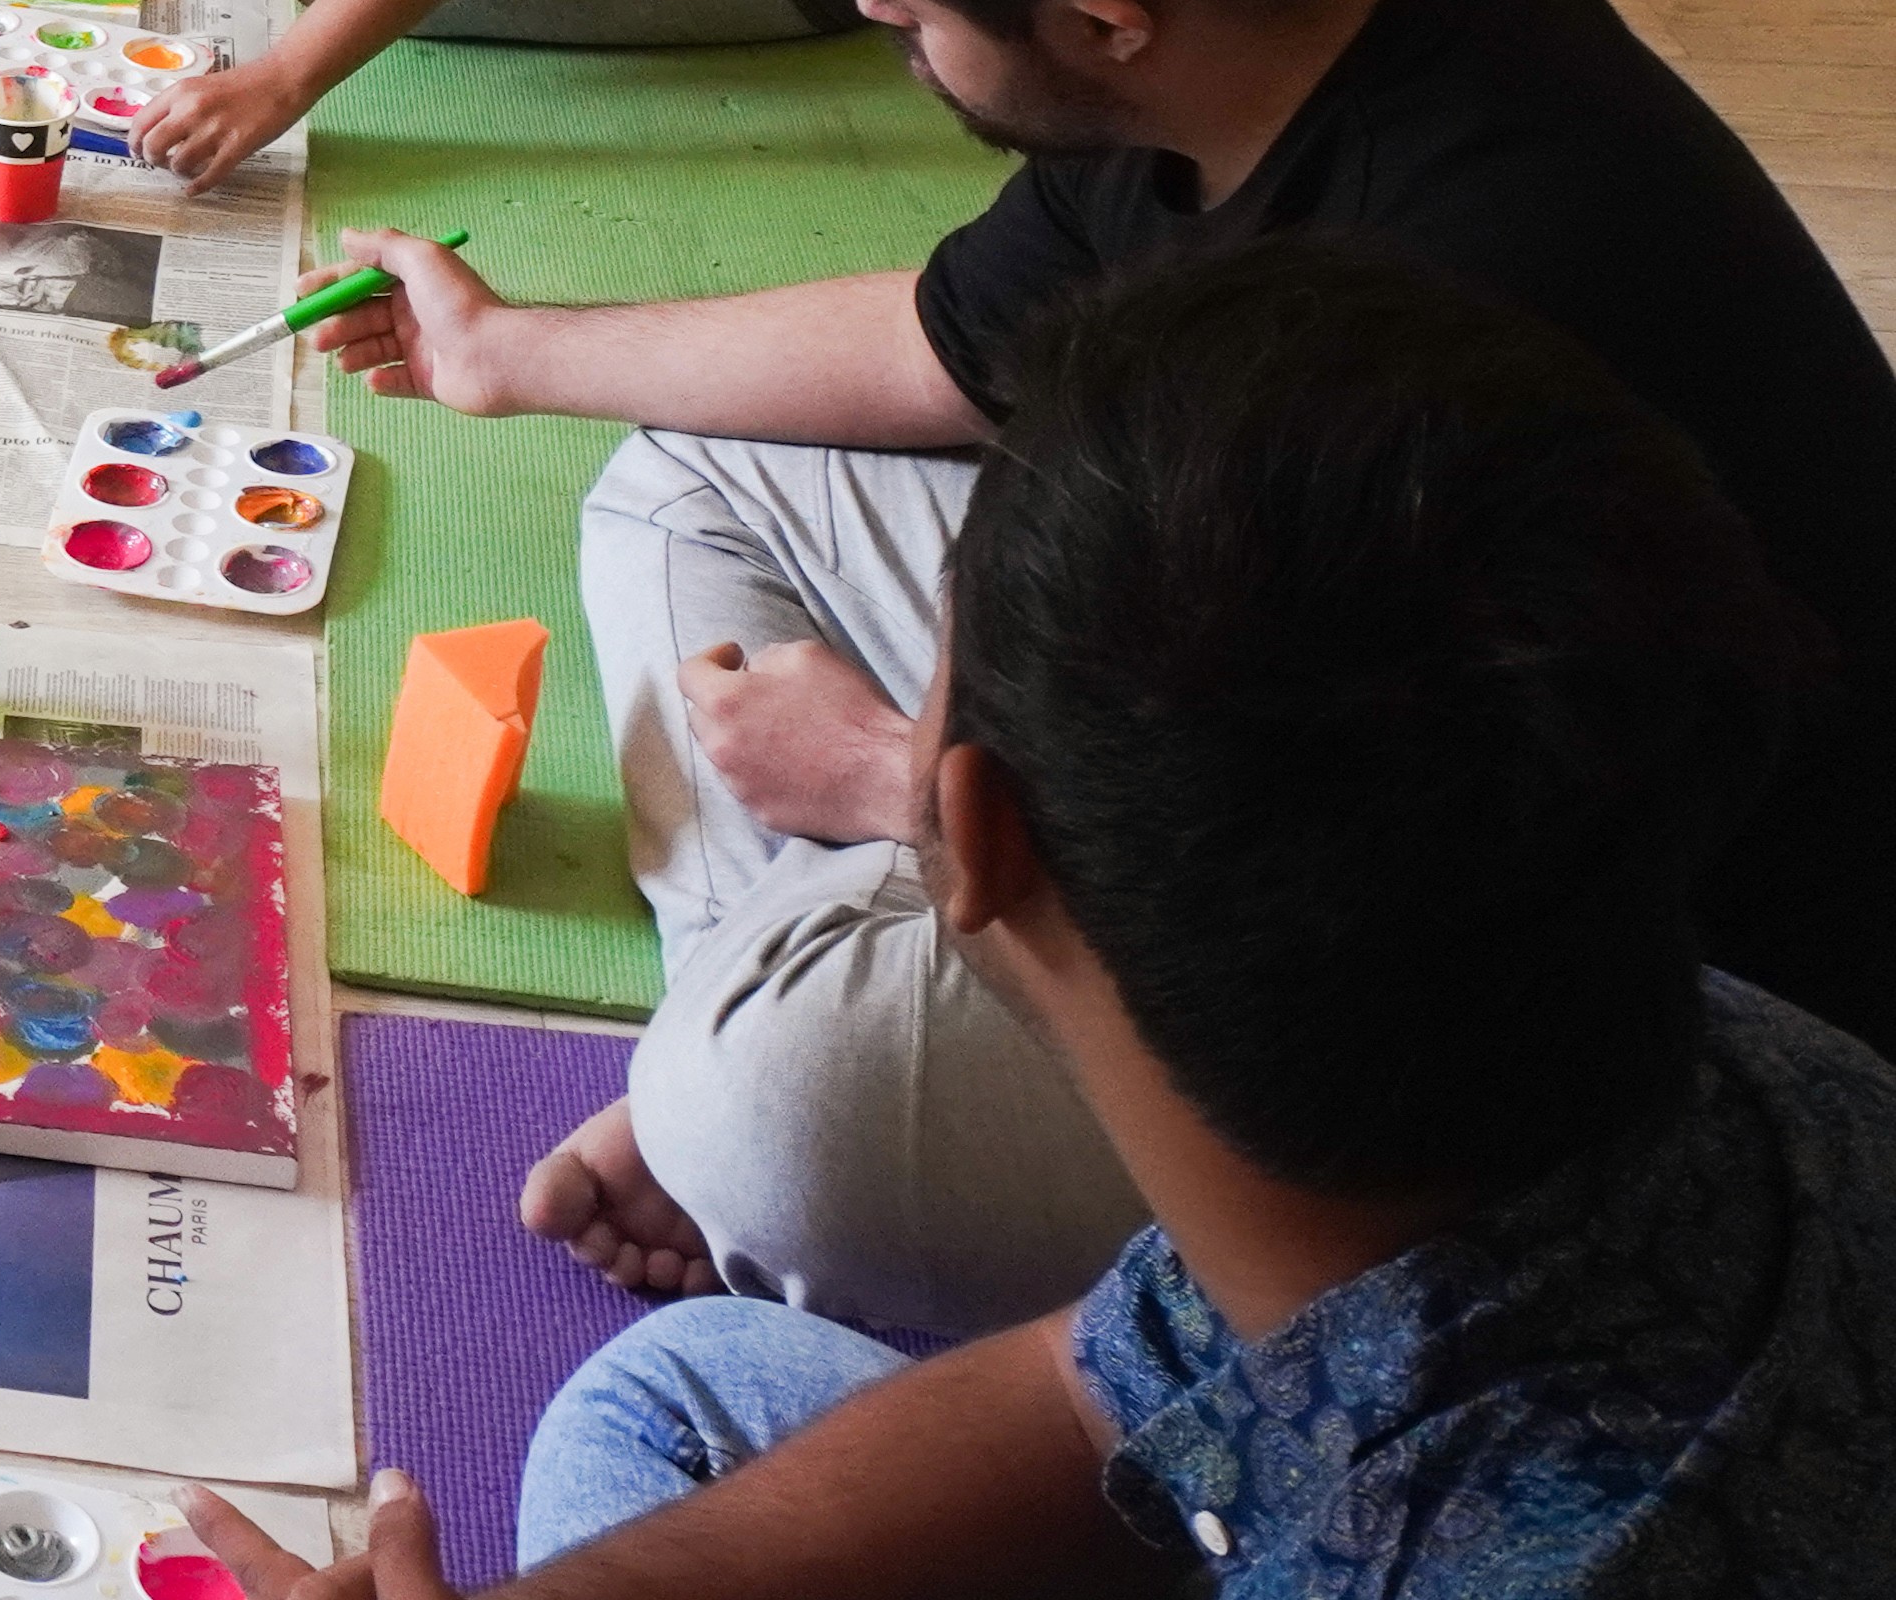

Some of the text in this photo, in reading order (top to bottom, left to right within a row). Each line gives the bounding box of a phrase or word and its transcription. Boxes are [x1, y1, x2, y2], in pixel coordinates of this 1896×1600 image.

[94, 155, 111, 164] in
[11, 326, 38, 338] not
[39, 329, 101, 349] rhetoric
[34, 434, 52, 446] to
[192, 1197, 209, 1246] PARIS
